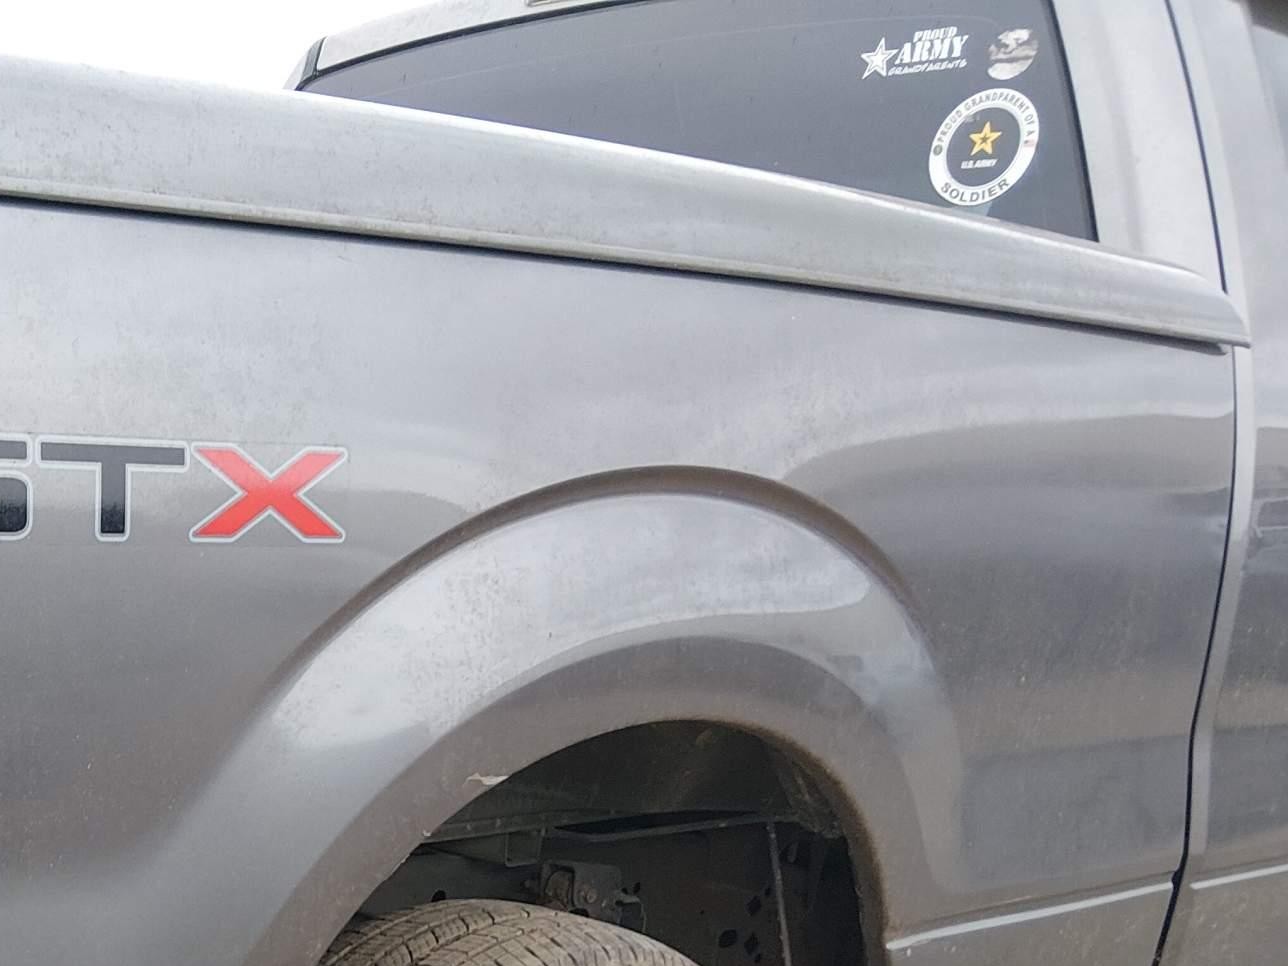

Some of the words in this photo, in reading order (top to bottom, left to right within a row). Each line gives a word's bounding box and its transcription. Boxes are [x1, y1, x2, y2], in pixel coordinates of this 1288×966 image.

[913, 26, 957, 42] PROUD
[895, 35, 968, 64] ARMY
[938, 109, 963, 143] PROUD
[964, 91, 1030, 114] GRANDPARENT
[1024, 114, 1036, 126] OF
[941, 178, 1010, 203] SOLDIER
